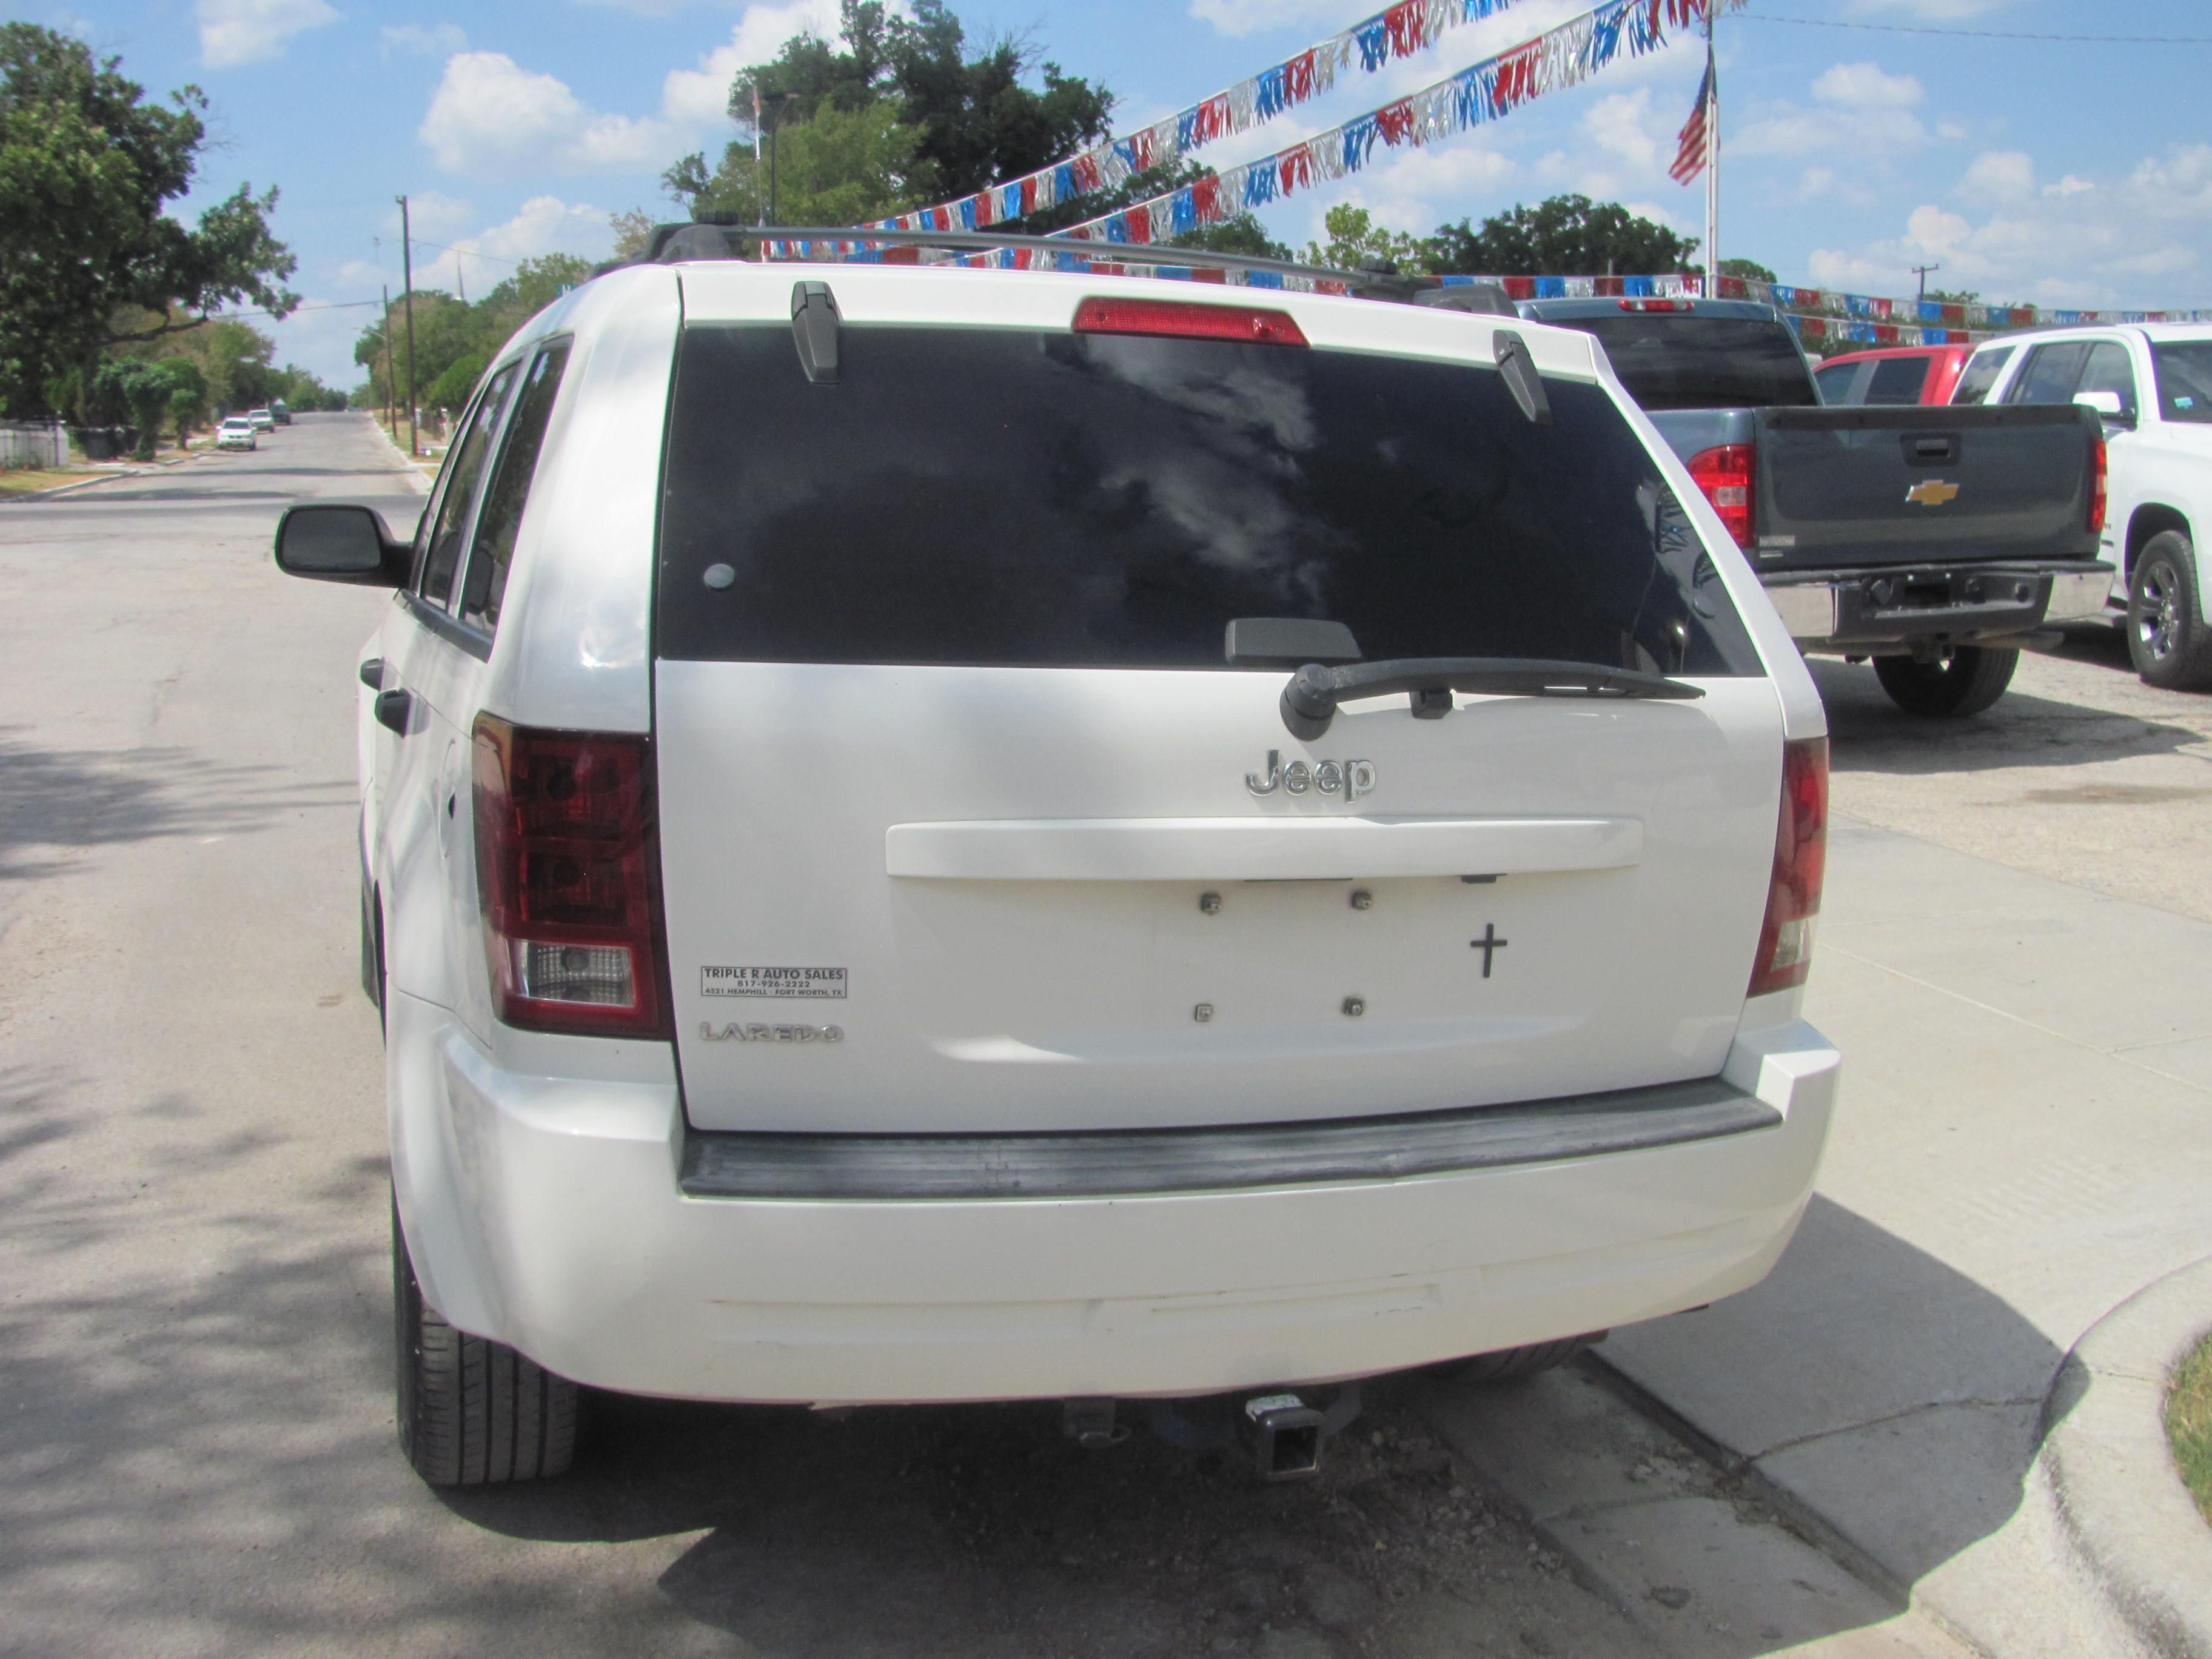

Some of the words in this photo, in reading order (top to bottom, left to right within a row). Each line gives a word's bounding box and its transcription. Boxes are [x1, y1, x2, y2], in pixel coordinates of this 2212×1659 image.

[1245, 749, 1376, 803] Jeep
[705, 968, 746, 979] TRIPLE
[752, 969, 759, 979] R
[763, 970, 800, 979] AUTO
[805, 970, 843, 980] SALES
[700, 1021, 845, 1042] LAREDO
